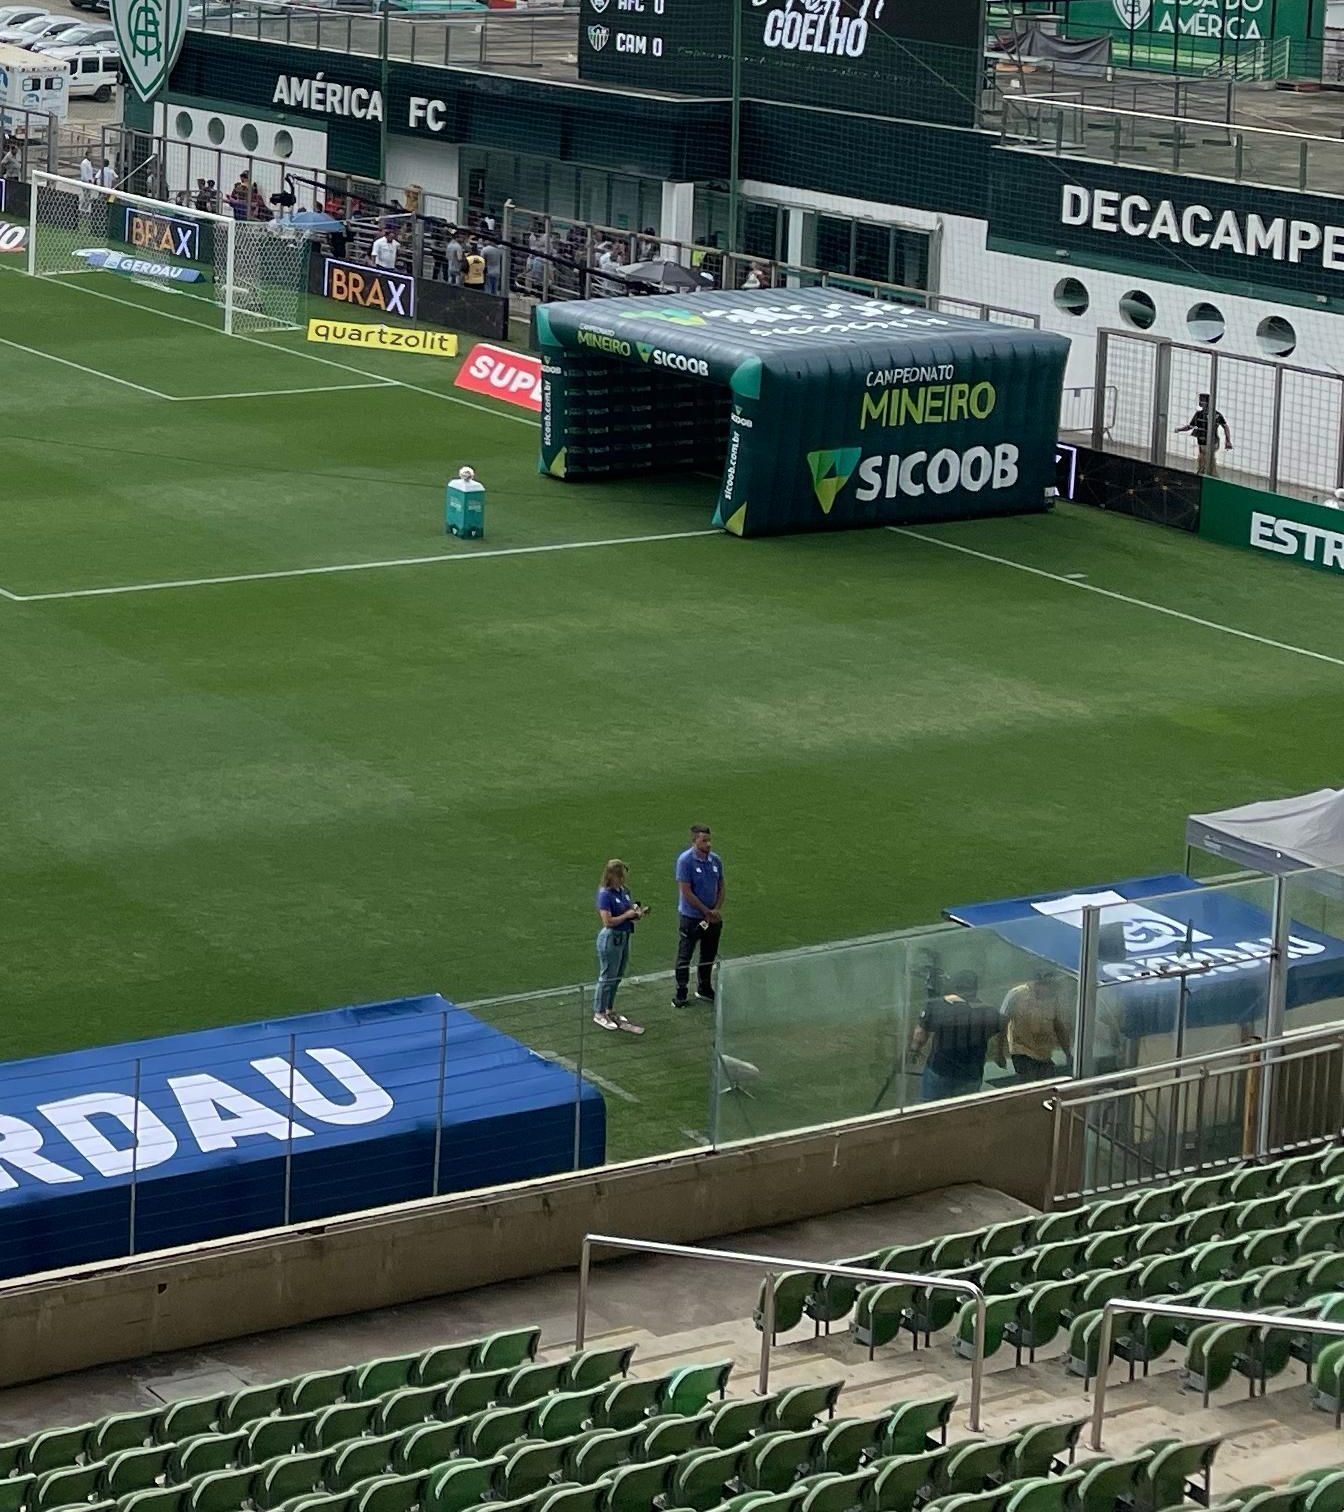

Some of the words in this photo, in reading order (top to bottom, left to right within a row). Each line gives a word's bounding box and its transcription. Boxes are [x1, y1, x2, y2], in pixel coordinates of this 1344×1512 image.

[616, 32, 647, 56] CAM
[652, 38, 663, 57] 0
[763, 8, 869, 57] COELHO
[1159, 9, 1262, 40] AMÉRICA
[272, 72, 383, 122] AMÉRICA
[408, 96, 447, 132] FC
[132, 216, 192, 259] BRAX
[1062, 185, 1344, 271] DECACAMPE
[120, 258, 183, 279] GERDAU
[332, 267, 405, 316] BRAX
[315, 324, 448, 352] quartzolit
[577, 329, 631, 357] MINEIRO
[653, 349, 709, 377] SICOOB
[866, 364, 954, 387] CAMPEONATO
[859, 381, 997, 430] MINEIRO
[855, 443, 1020, 502] SICOOB
